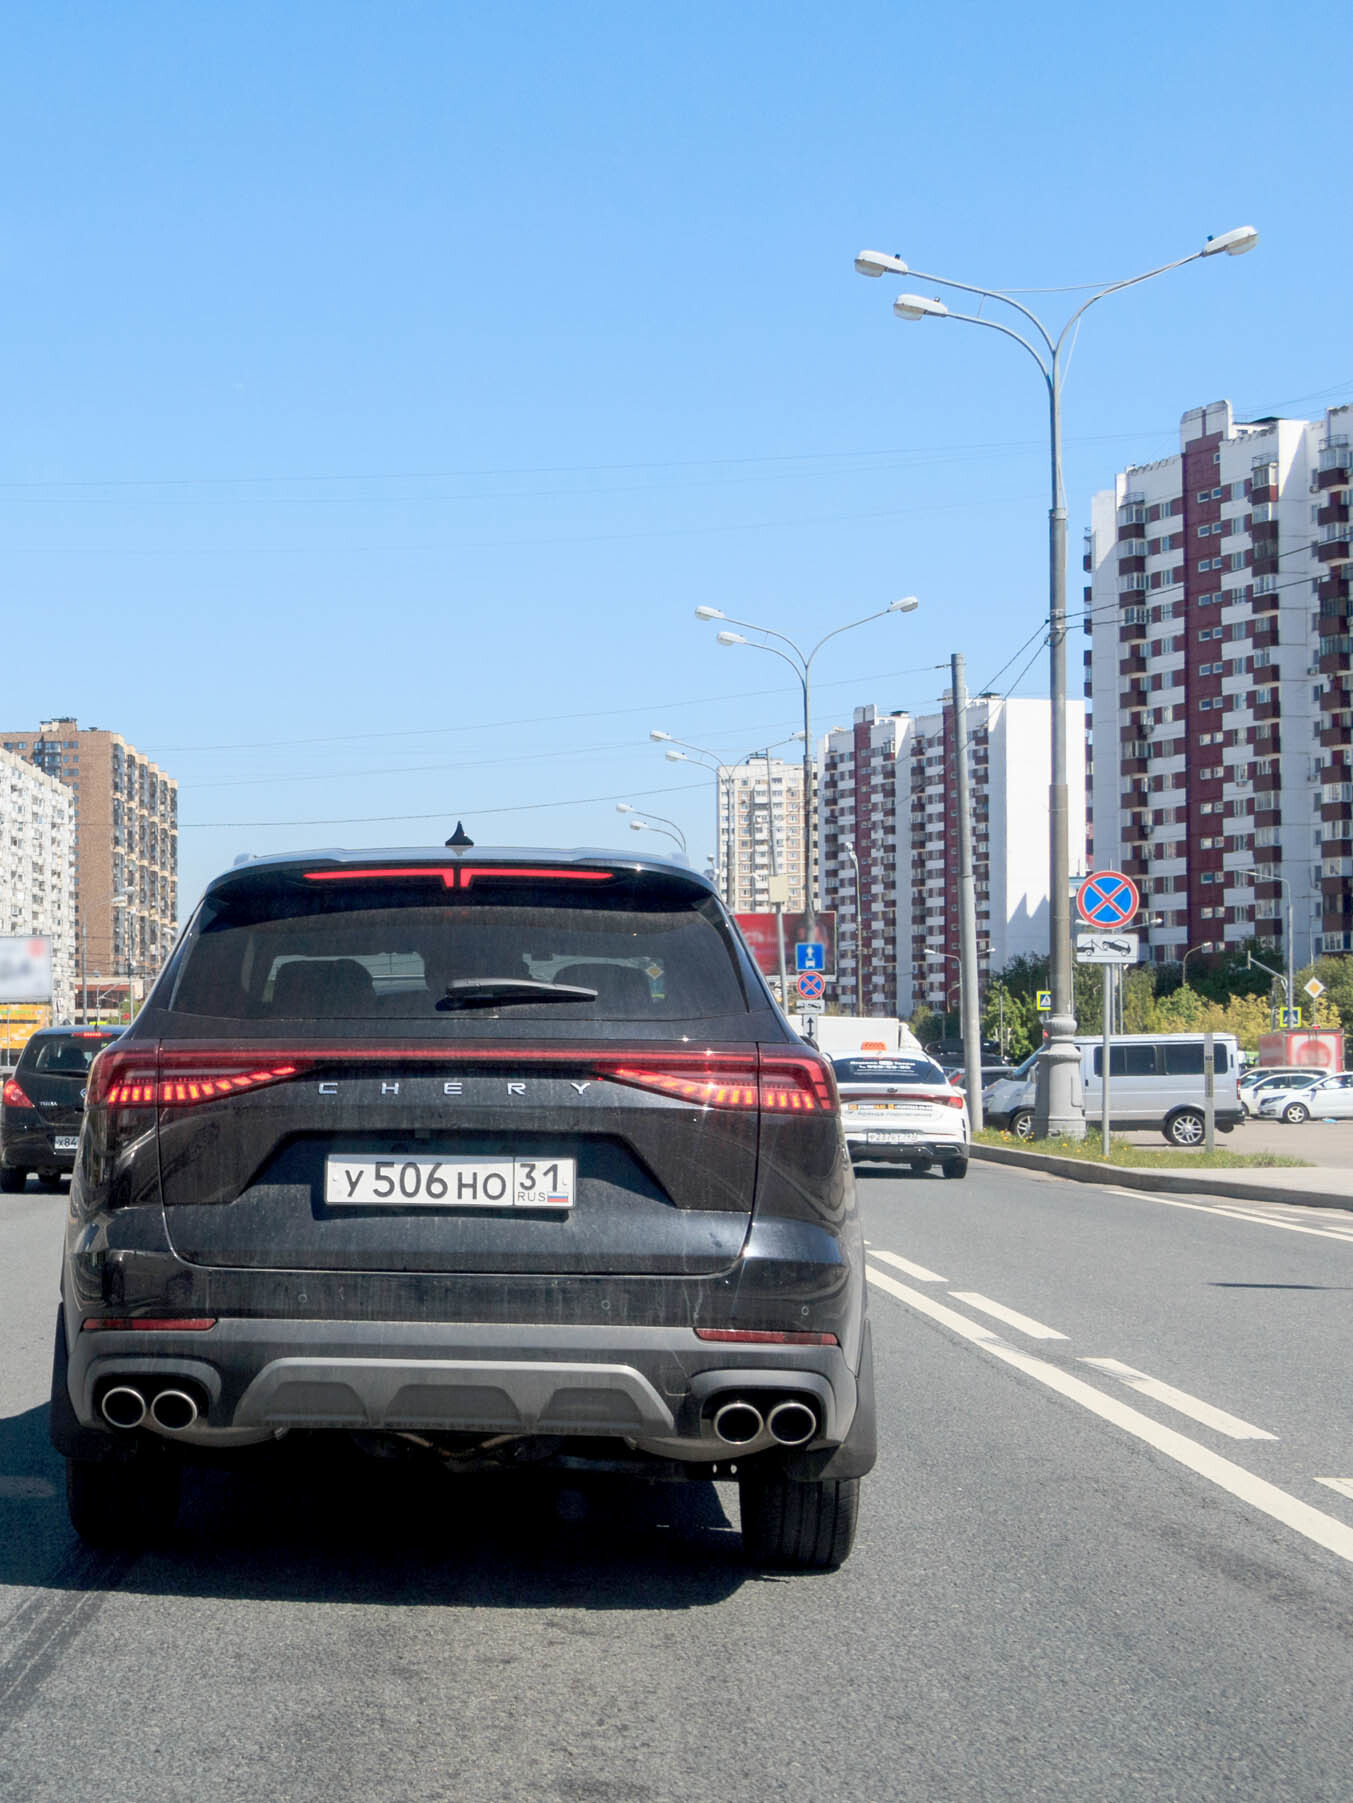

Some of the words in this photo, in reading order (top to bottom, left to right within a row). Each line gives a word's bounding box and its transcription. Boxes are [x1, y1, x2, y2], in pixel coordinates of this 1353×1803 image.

[318, 1082, 591, 1095] CHERY
[519, 1163, 559, 1192] 31
[517, 1191, 546, 1202] RUS
